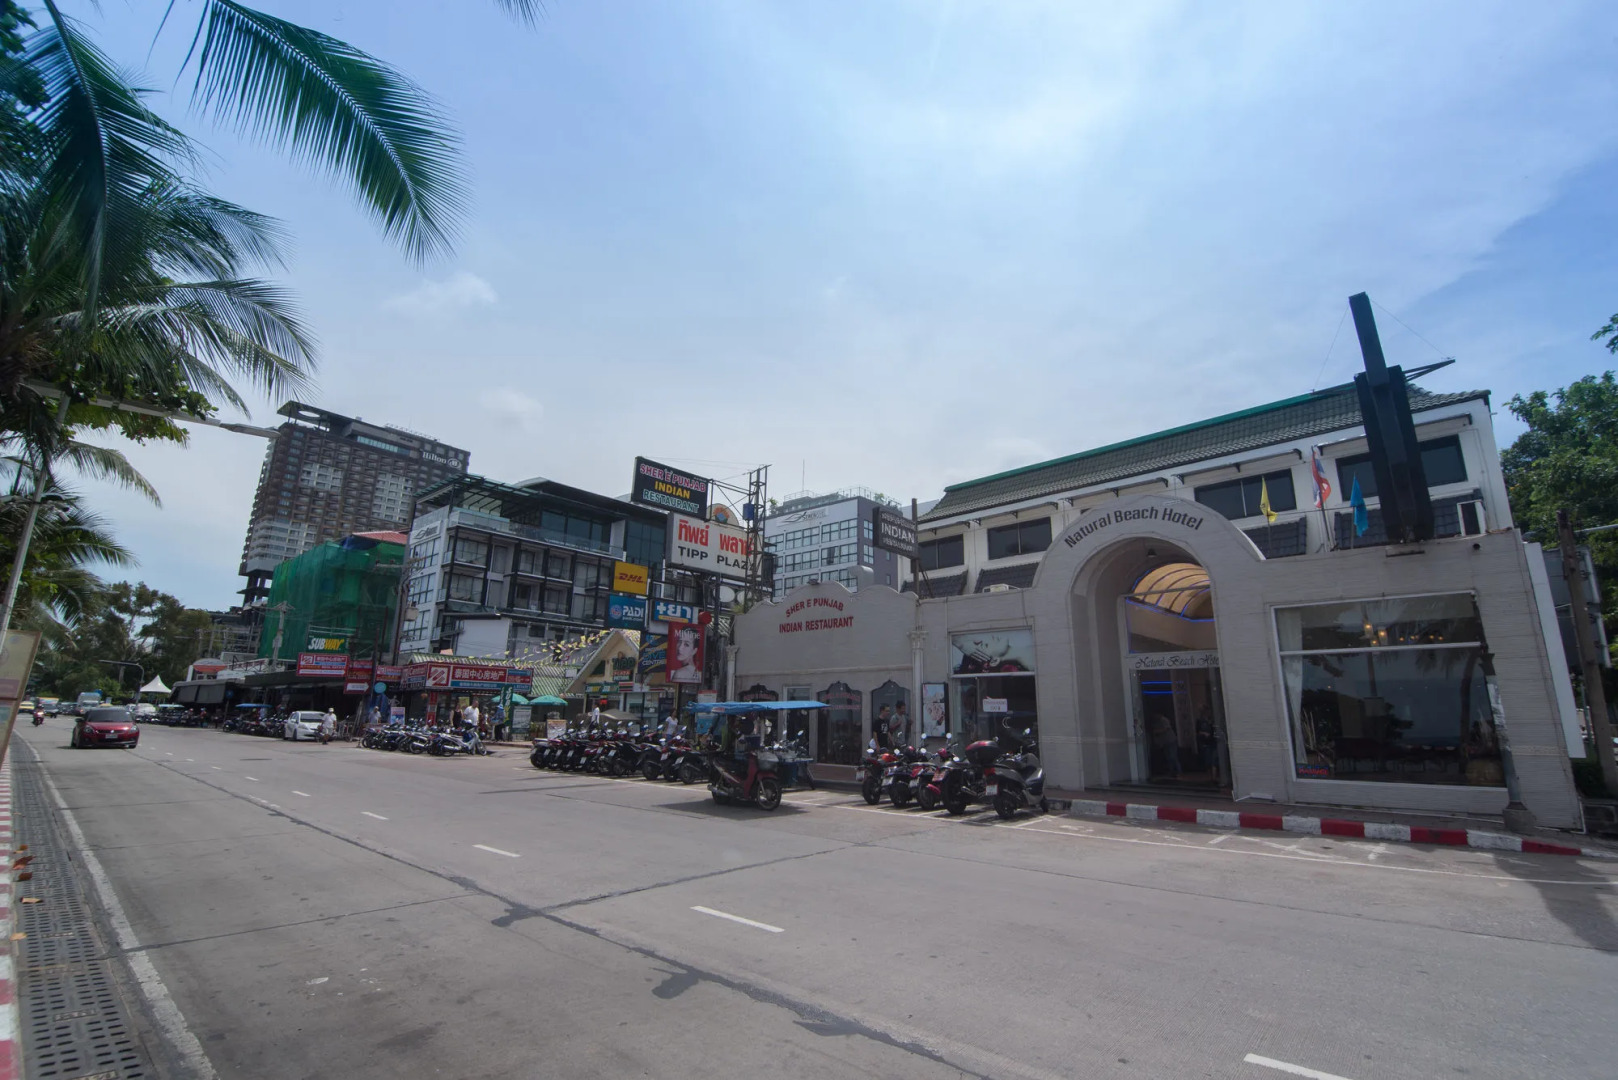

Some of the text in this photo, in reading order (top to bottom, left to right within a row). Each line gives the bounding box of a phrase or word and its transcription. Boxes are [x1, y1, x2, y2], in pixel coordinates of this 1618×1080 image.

[422, 451, 447, 465] Hilton
[640, 463, 664, 480] SHER
[672, 475, 707, 493] PUNJAB
[654, 481, 691, 499] INDIAN
[643, 489, 700, 513] RESTAURANT
[881, 522, 915, 543] INDIAN
[1064, 506, 1205, 549] Natural Beach Hotel
[678, 545, 709, 560] TIPP
[619, 572, 645, 584] DHL
[622, 605, 645, 617] PADI
[785, 597, 844, 618] SHER E PUNJAB
[778, 615, 854, 634] INDIAN RESTAURANT
[308, 638, 345, 651] SUBWAY
